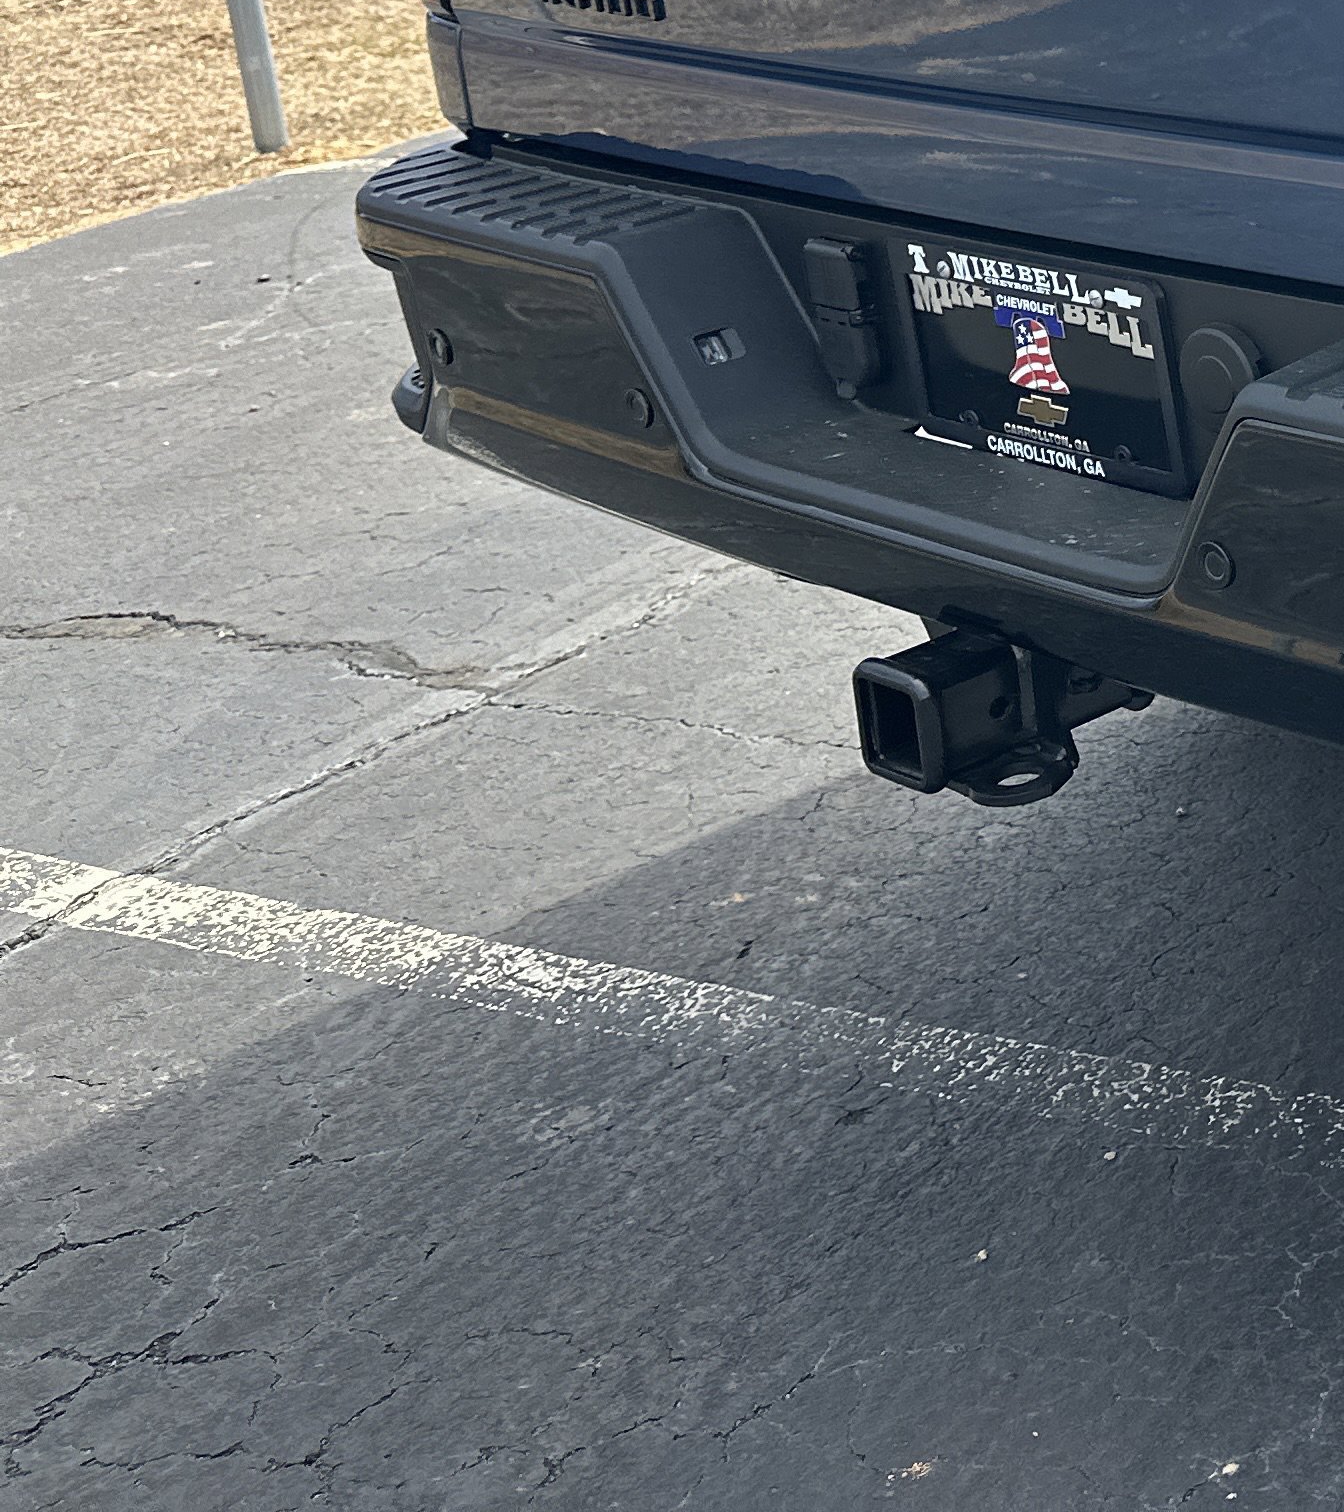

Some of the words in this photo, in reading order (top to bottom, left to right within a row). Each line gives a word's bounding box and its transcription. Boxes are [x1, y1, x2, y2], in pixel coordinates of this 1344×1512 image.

[947, 251, 1013, 283] MIKE
[1016, 264, 1090, 305] BELL
[984, 276, 1051, 295] CHEVROLET
[909, 273, 993, 315] MIKE
[1063, 303, 1154, 360] BELL
[996, 294, 1056, 317] CHEVROLET
[987, 434, 1082, 474] CARROLLTON,
[1083, 458, 1106, 478] GA
[1074, 438, 1091, 453] GA
